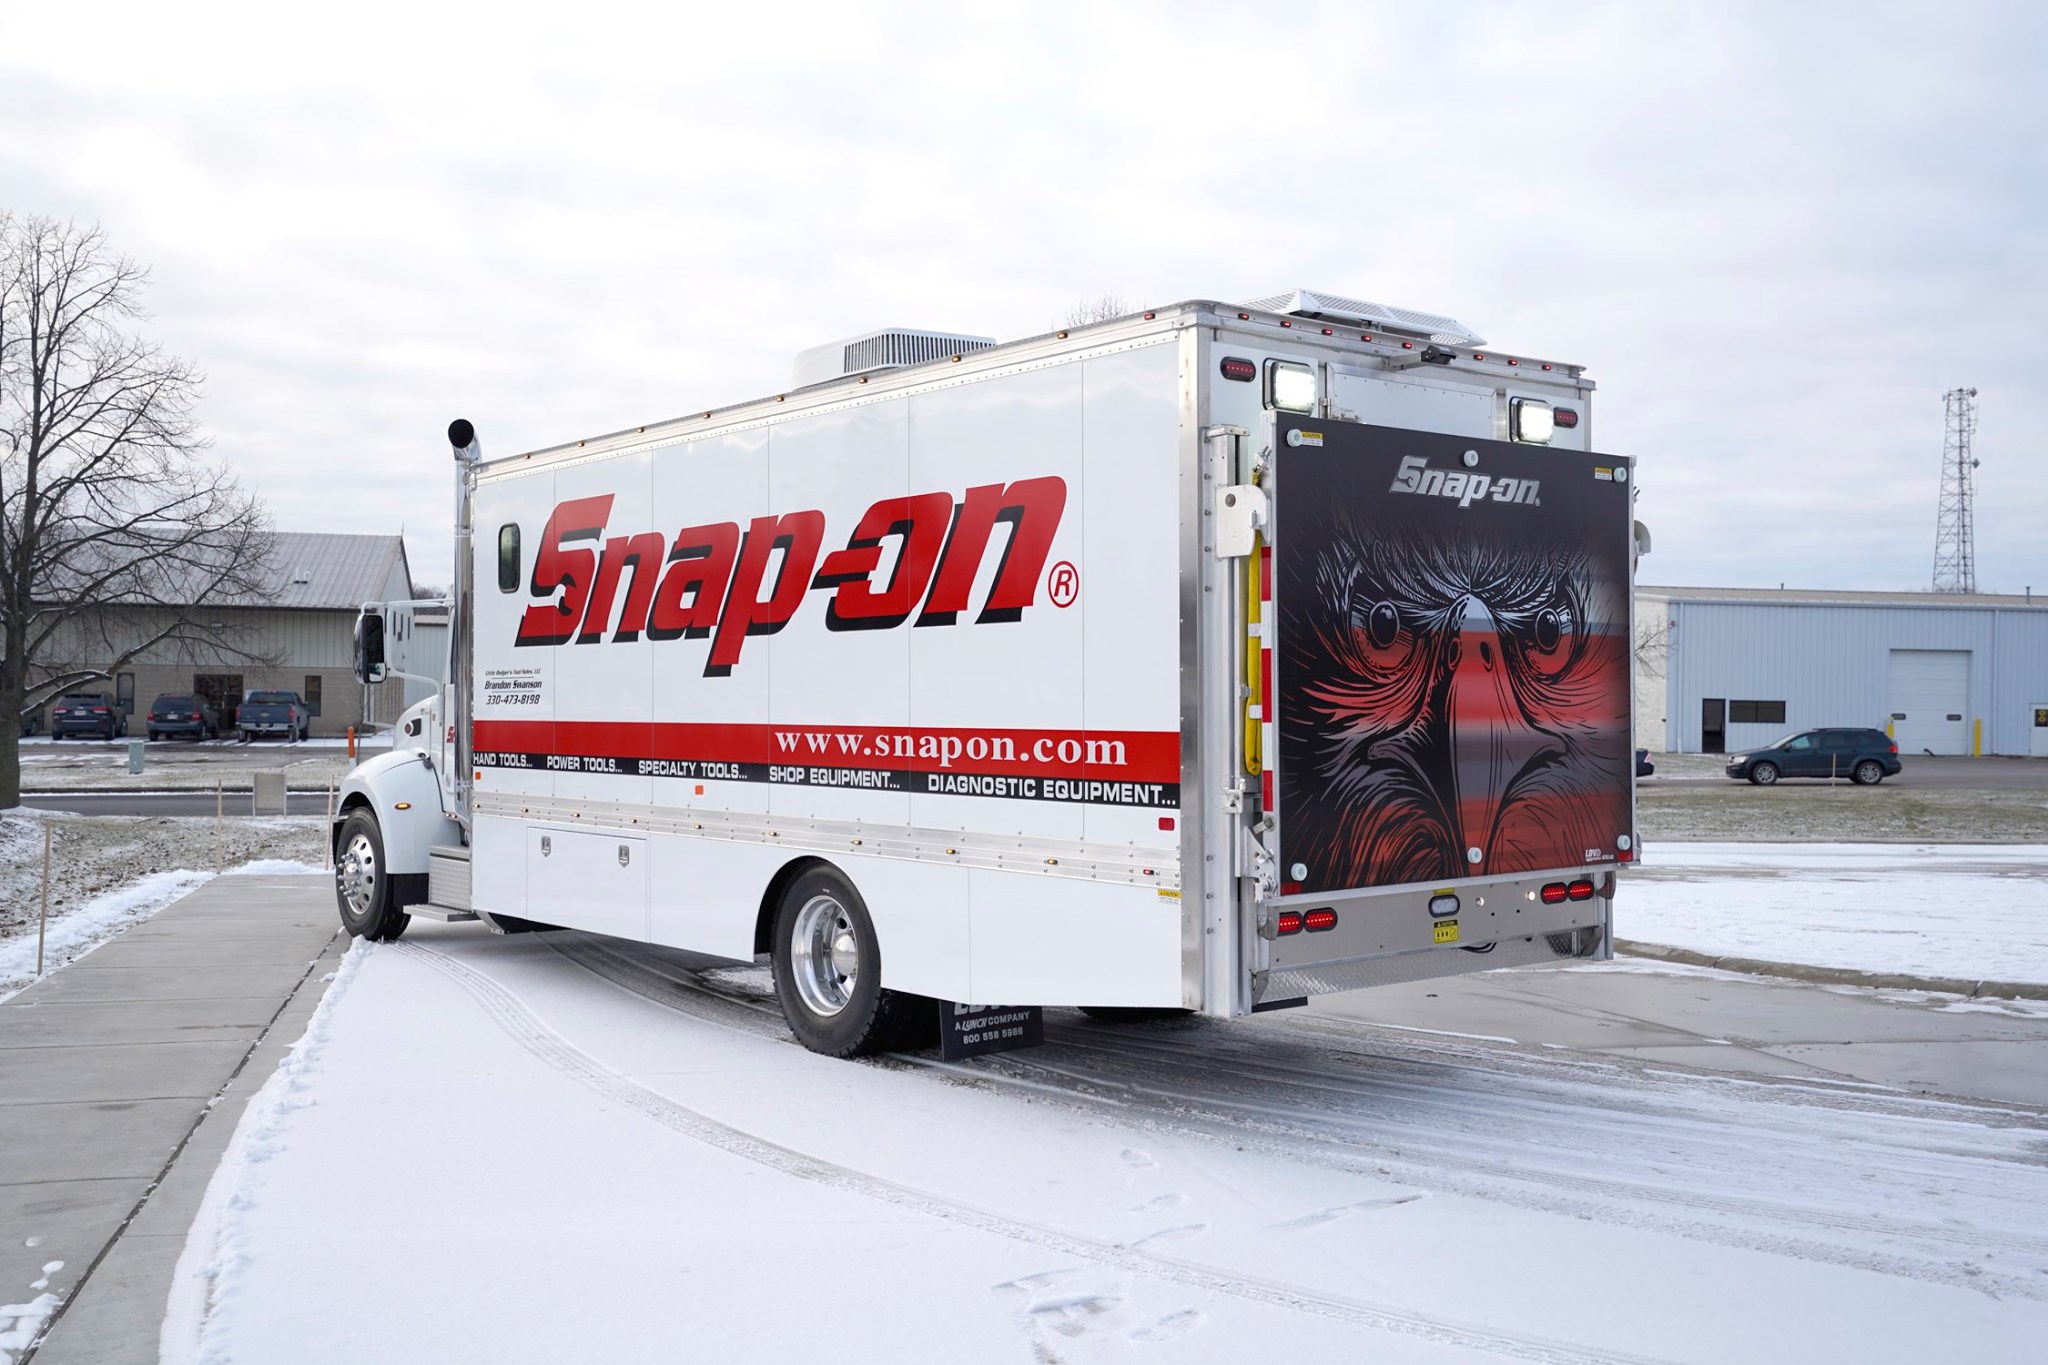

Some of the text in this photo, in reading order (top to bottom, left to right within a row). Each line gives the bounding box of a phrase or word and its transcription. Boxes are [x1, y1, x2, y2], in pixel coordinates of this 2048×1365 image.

[484, 679, 542, 690] Brandon Swanson
[775, 732, 1128, 767] www.snapon.com
[473, 752, 496, 766] HAND
[547, 755, 580, 770] POWER
[638, 760, 697, 777] SPECIALTY
[769, 766, 805, 783] SHOP
[928, 774, 1036, 797] DIAGNOSTIC
[955, 1022, 961, 1031] A
[988, 1011, 1030, 1025] COMPANY
